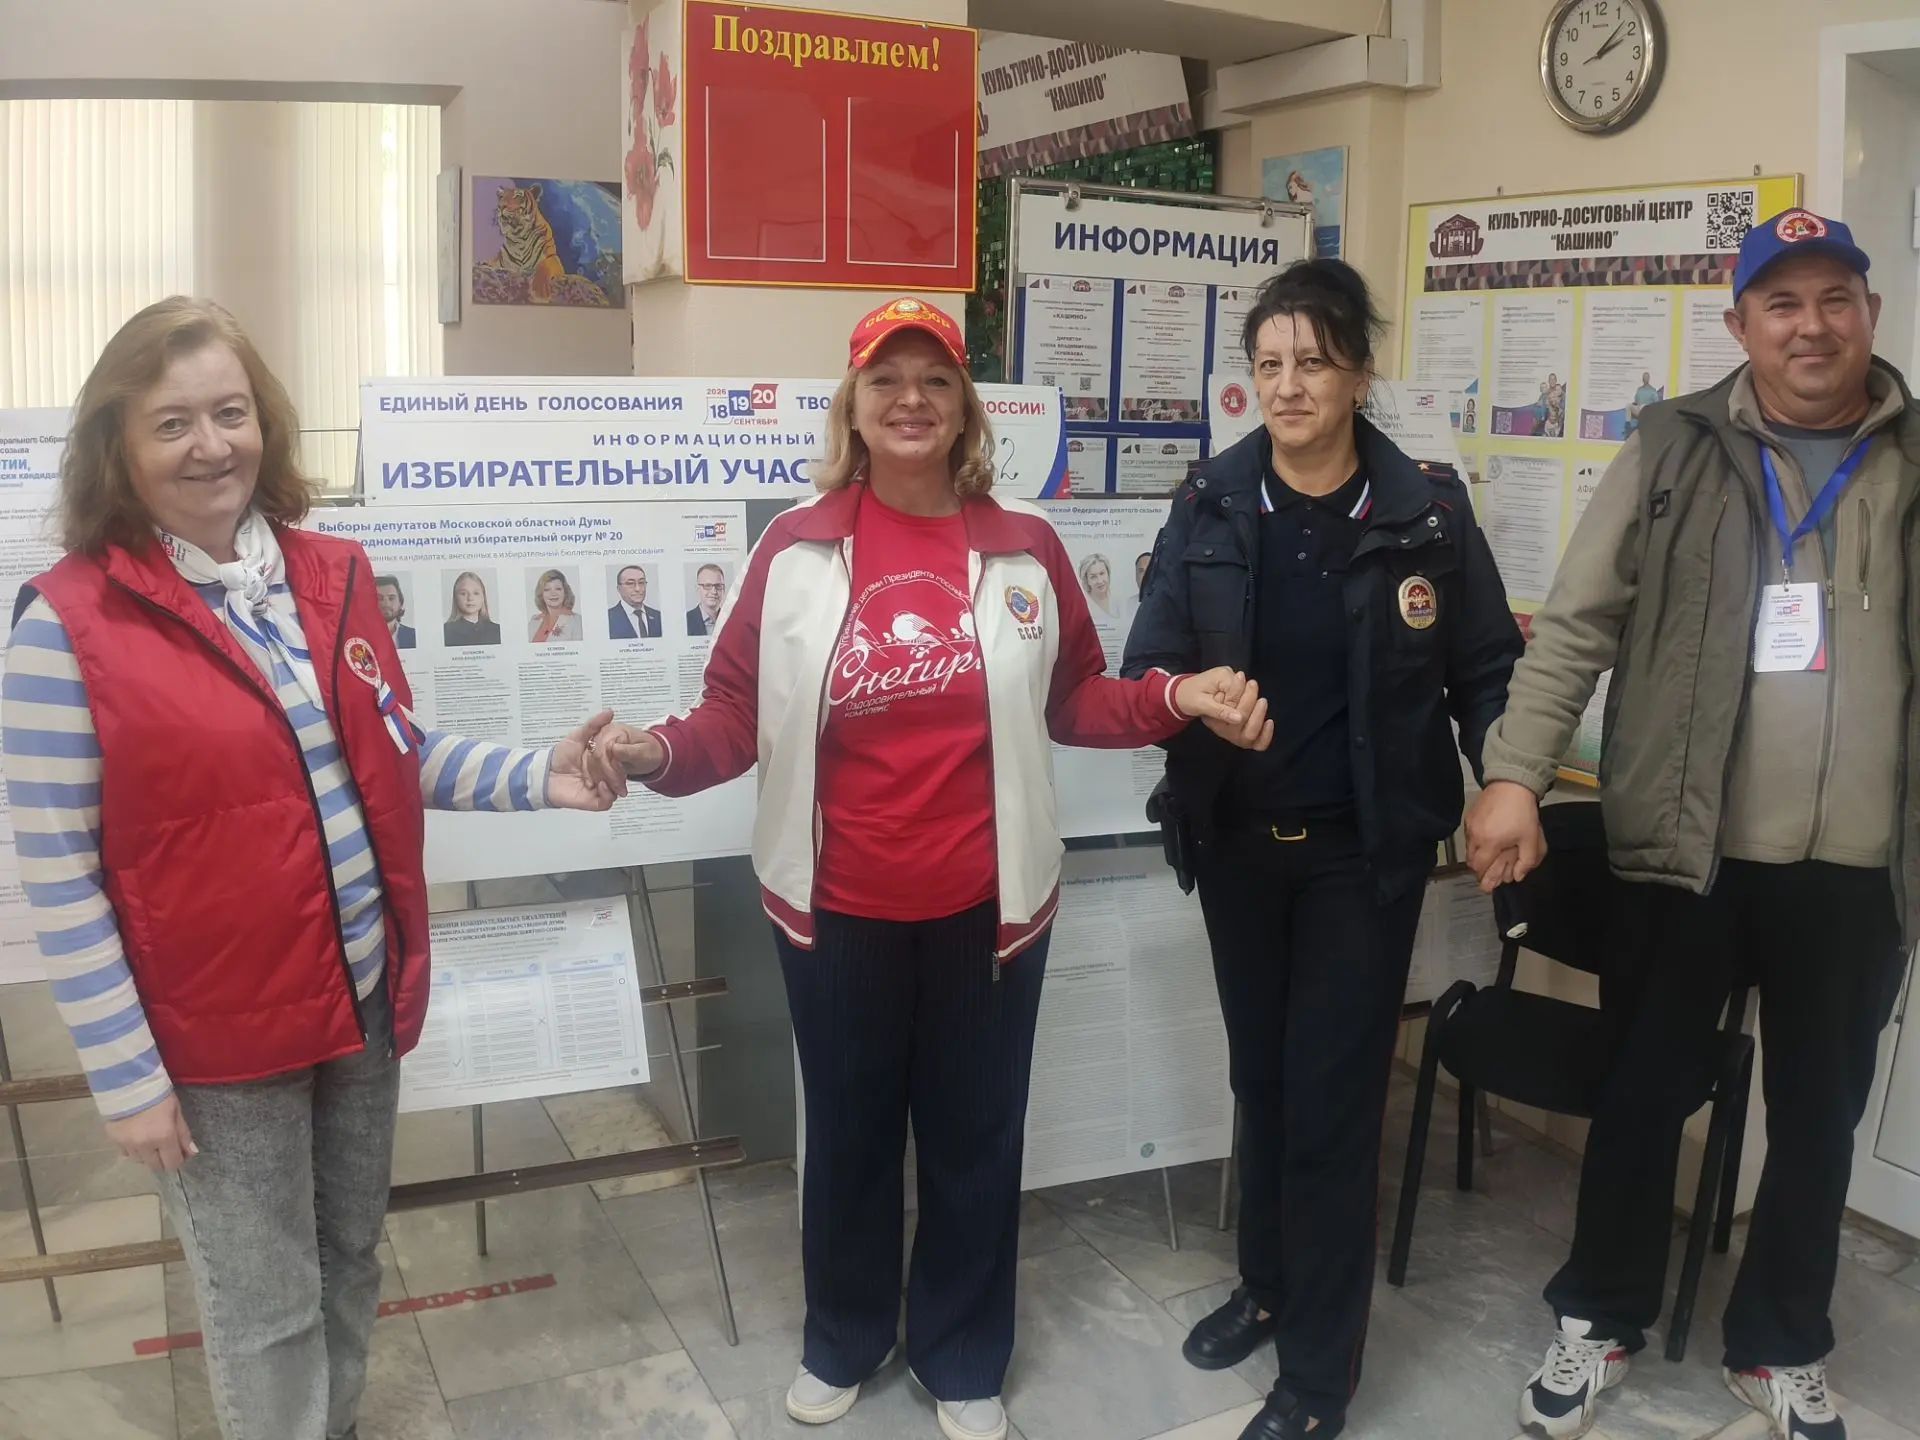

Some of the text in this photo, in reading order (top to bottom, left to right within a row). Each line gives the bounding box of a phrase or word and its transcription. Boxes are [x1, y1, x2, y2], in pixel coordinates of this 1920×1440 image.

[1594, 1, 1608, 16] 12
[1615, 6, 1622, 20] 1
[1579, 11, 1590, 25] 11
[1566, 28, 1579, 42] 10
[1627, 21, 1637, 36] 2
[711, 14, 940, 72] Поздравляем!
[1559, 52, 1569, 66] 9
[1632, 45, 1641, 61] 3
[1565, 74, 1573, 89] 8
[1625, 69, 1634, 84] 4
[1578, 90, 1586, 105] 7
[1611, 87, 1621, 102] 5
[1593, 95, 1603, 110] 6
[1488, 200, 1694, 231] КУЛЬТУРНО-ДОСУГОВЫЙ ЦЕНТР
[1054, 221, 1279, 268] ИНФОРМАЦИЯ
[706, 388, 727, 396] 2026
[379, 393, 684, 413] ЕДИНЫЙ ДЕНЬ ГОЛОСОВАНИЯ
[709, 389, 775, 419] 18 19 20
[733, 418, 778, 426] СЕНТЯБРЯ
[593, 431, 816, 448] ИНФОРМАЦИОННЫЙ
[19, 472, 63, 481] кандида
[382, 453, 824, 490] ИЗБИРАТЕЛЬНЫЙ УЧАС
[318, 516, 612, 534] Выборы депутатов Московской областной Думы
[361, 531, 623, 548] одномандатный избирательный округ № 20
[882, 569, 935, 585] Президента
[1017, 625, 1044, 641] СССР
[846, 683, 938, 712] Оздоровительный
